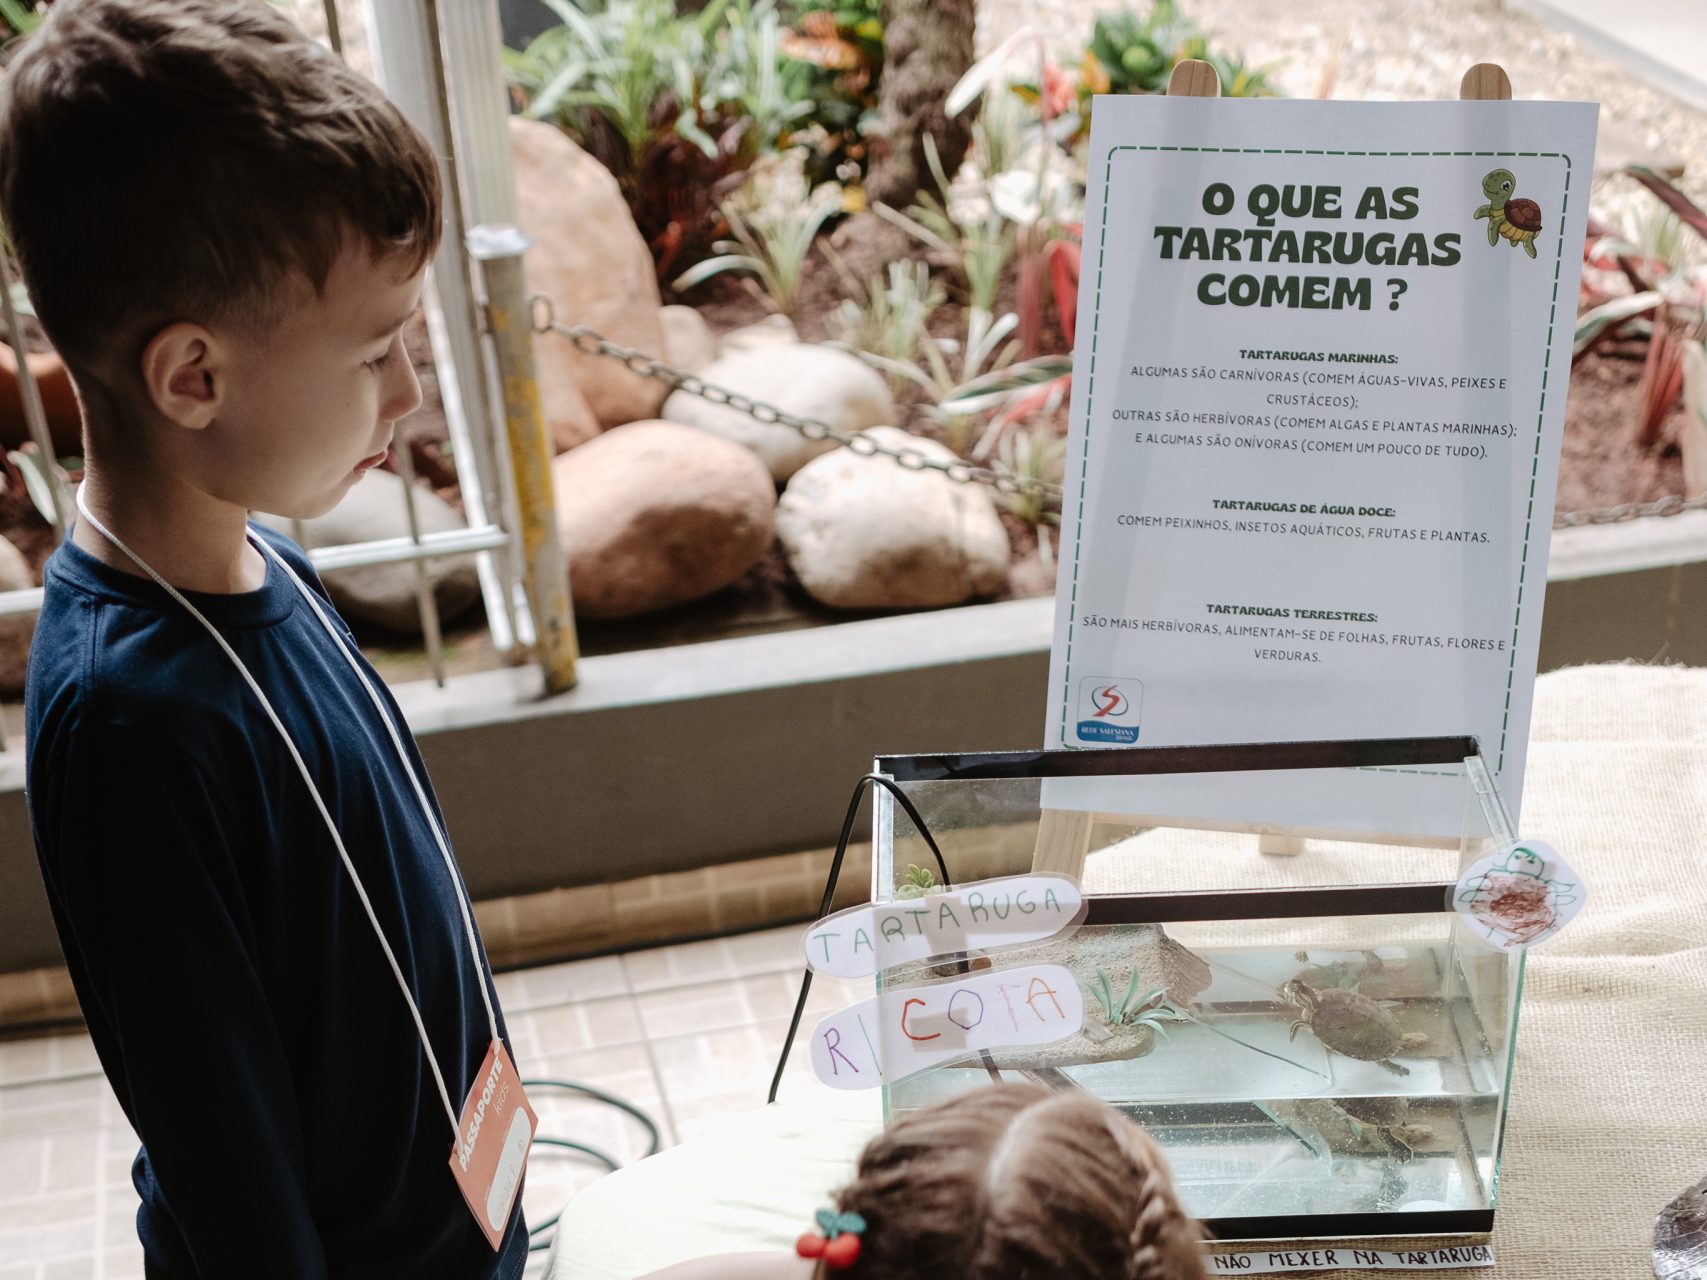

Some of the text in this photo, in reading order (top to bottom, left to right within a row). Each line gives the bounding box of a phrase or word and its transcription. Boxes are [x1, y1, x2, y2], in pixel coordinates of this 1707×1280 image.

[1202, 183, 1419, 226] O QUE AS
[1153, 226, 1461, 266] TARTARUGAS
[1197, 273, 1408, 311] COMEM ?
[1239, 350, 1399, 364] TARTARUGAS MARINHAS:
[1131, 366, 1187, 377] ALGUMAS
[1191, 366, 1216, 379] SÃO
[1220, 368, 1299, 382] CARNÍVORAS
[1303, 371, 1354, 385] (COMEM
[1451, 378, 1496, 389] PEIXES
[1499, 379, 1506, 389] E
[1267, 393, 1359, 409] CRUSTÁCEOS);
[1112, 410, 1517, 438] OUTRAS SÃO HERBÍVORAS (COMEM ALGAS E PLANTAS MARINHAS);
[1135, 433, 1488, 460] E ALGUMAS SÃO ONÍVORAS (COMEM UM POUCO DE TUDO).
[1212, 500, 1396, 517] TARTARUGAS DE ÁGUA DOCE:
[1117, 515, 1490, 543] COMEM PEIXINHOS, INSETOS AQUÁTICOS, FRUTAS E PLANTAS.
[1207, 604, 1378, 622] TARTARUGAS TERRESTRES:
[1083, 615, 1505, 650] SÃO MAIS HERBÍVORAS, ALIMENTAM-SE DE FOLHAS, FRUTAS, FLORES E
[1255, 649, 1321, 663] VERDURAS.
[813, 888, 1061, 963] TARTARUGA
[493, 1082, 509, 1118] kids
[459, 1058, 503, 1171] PASSAPORTE
[1214, 1246, 1493, 1269] NÃO MEXER NA TARTARUGA
